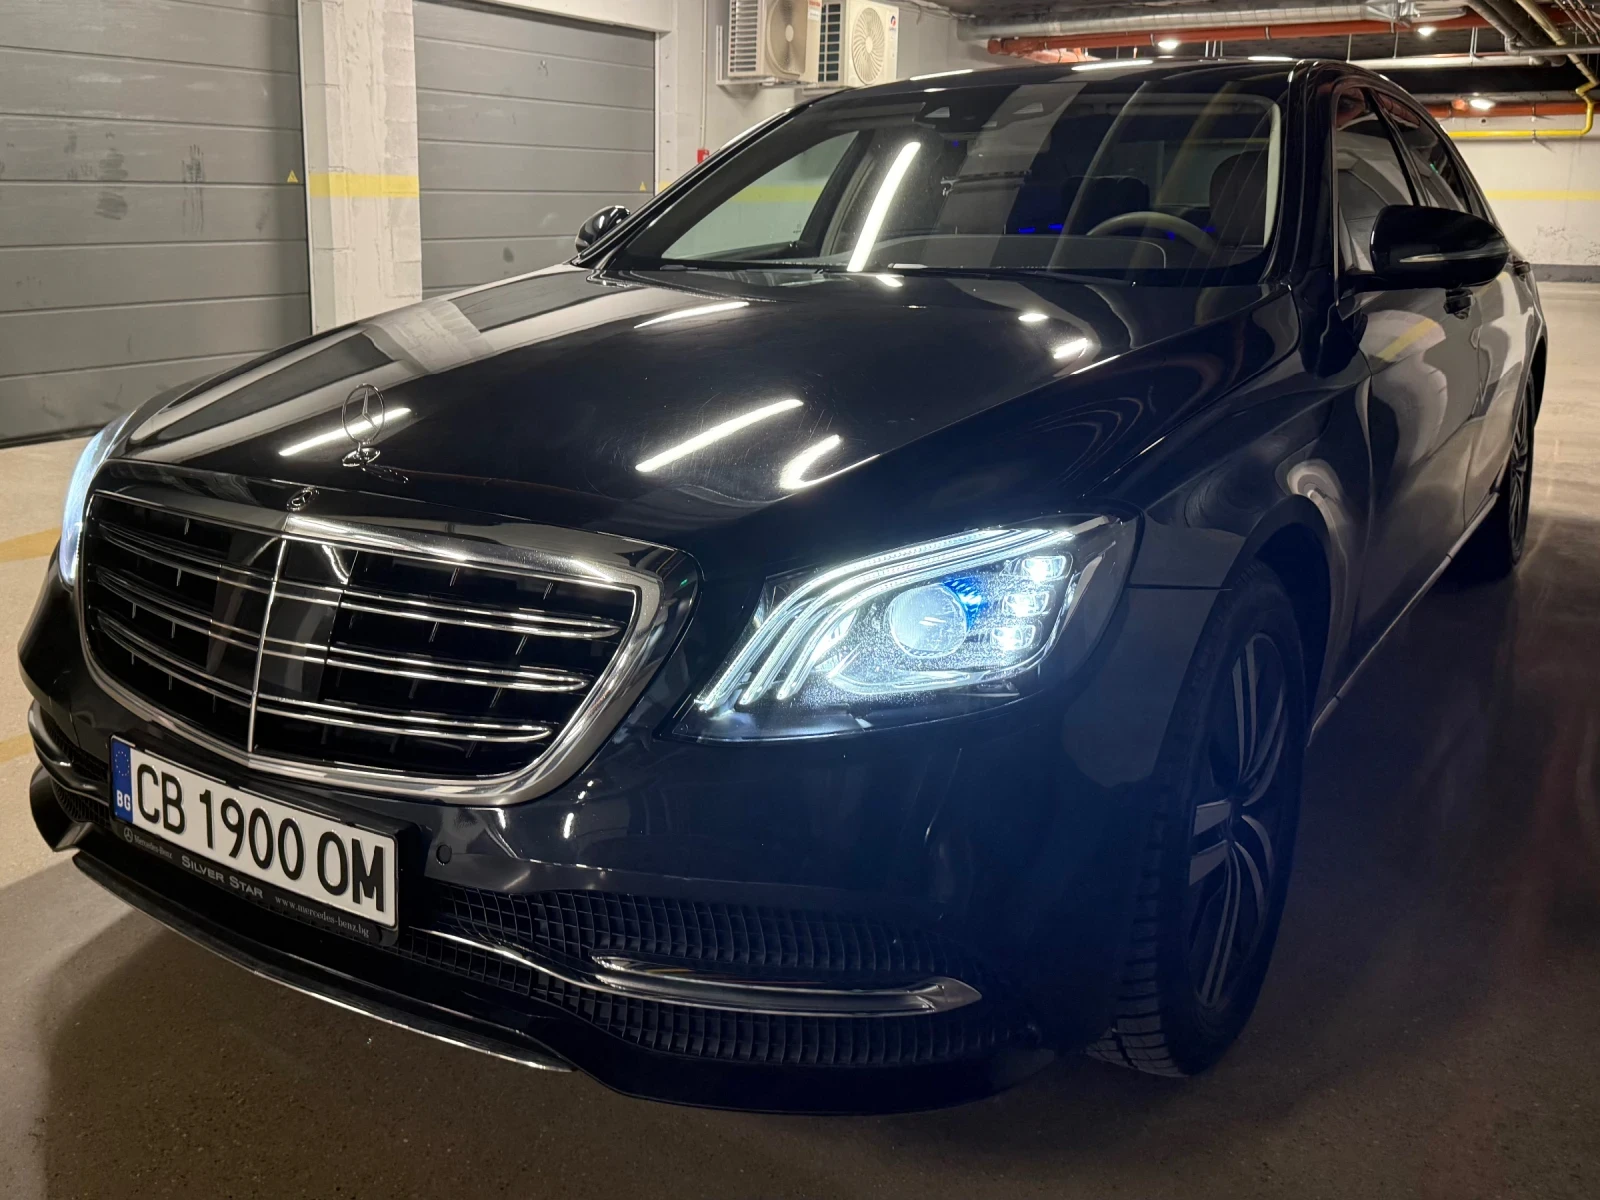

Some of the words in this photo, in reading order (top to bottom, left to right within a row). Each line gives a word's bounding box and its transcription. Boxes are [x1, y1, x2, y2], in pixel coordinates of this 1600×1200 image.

[116, 790, 132, 812] BG
[133, 834, 174, 861] Mercedes-Benz
[136, 763, 186, 835] CB
[199, 788, 305, 881] 1900
[316, 830, 386, 913] OM
[181, 855, 226, 884] SILVER
[229, 875, 264, 899] STAR
[274, 895, 371, 939] www.mercedes-benz.bg
